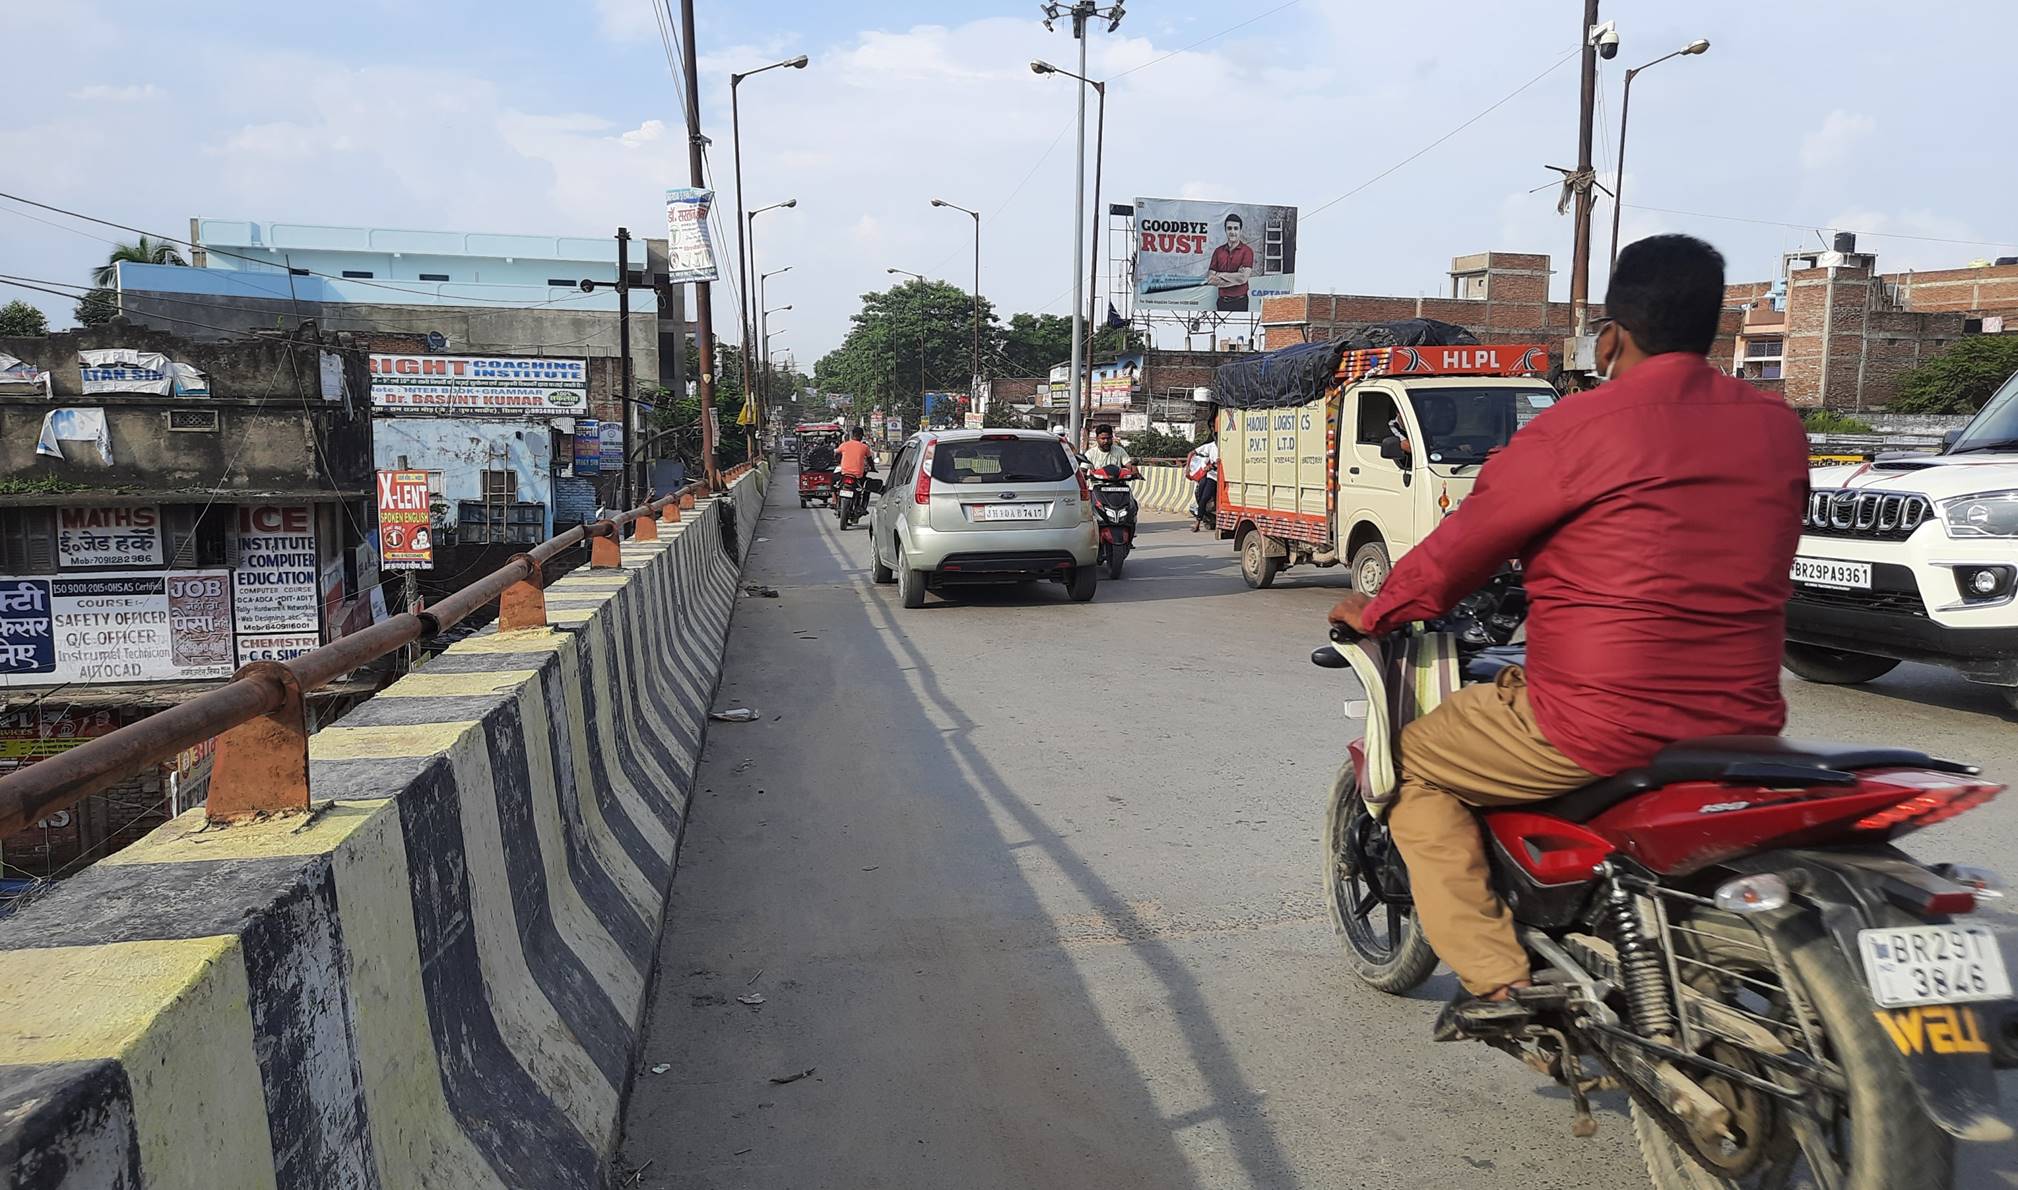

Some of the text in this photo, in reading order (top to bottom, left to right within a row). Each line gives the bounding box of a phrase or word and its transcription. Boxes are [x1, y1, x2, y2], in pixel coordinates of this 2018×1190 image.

[1141, 219, 1208, 234] GOODBYE
[1141, 232, 1208, 254] RUST
[473, 360, 581, 371] COACHING
[1443, 350, 1500, 369] HLPL
[473, 370, 581, 380] INSTITUTE
[385, 393, 407, 403] Dr.
[483, 395, 544, 406] KUMAR
[379, 472, 428, 510] X-LENT
[62, 507, 155, 529] MATHS
[239, 506, 308, 533] ICE
[380, 511, 429, 523] SPOKEN ENGLISH
[249, 553, 316, 568] COMPUTER
[238, 571, 315, 586] EDUCATION
[1795, 562, 1868, 584] BR29PA9361
[53, 583, 67, 594] ISO
[135, 581, 163, 591] Certified
[171, 580, 223, 598] JOB
[239, 587, 278, 595] COMPUTER
[55, 611, 167, 627] SAFETY OFFICER
[97, 629, 156, 645] OFFICER
[241, 637, 317, 648] CHEMISTRY
[124, 646, 170, 660] Technician
[80, 663, 142, 679] AUTOCAD
